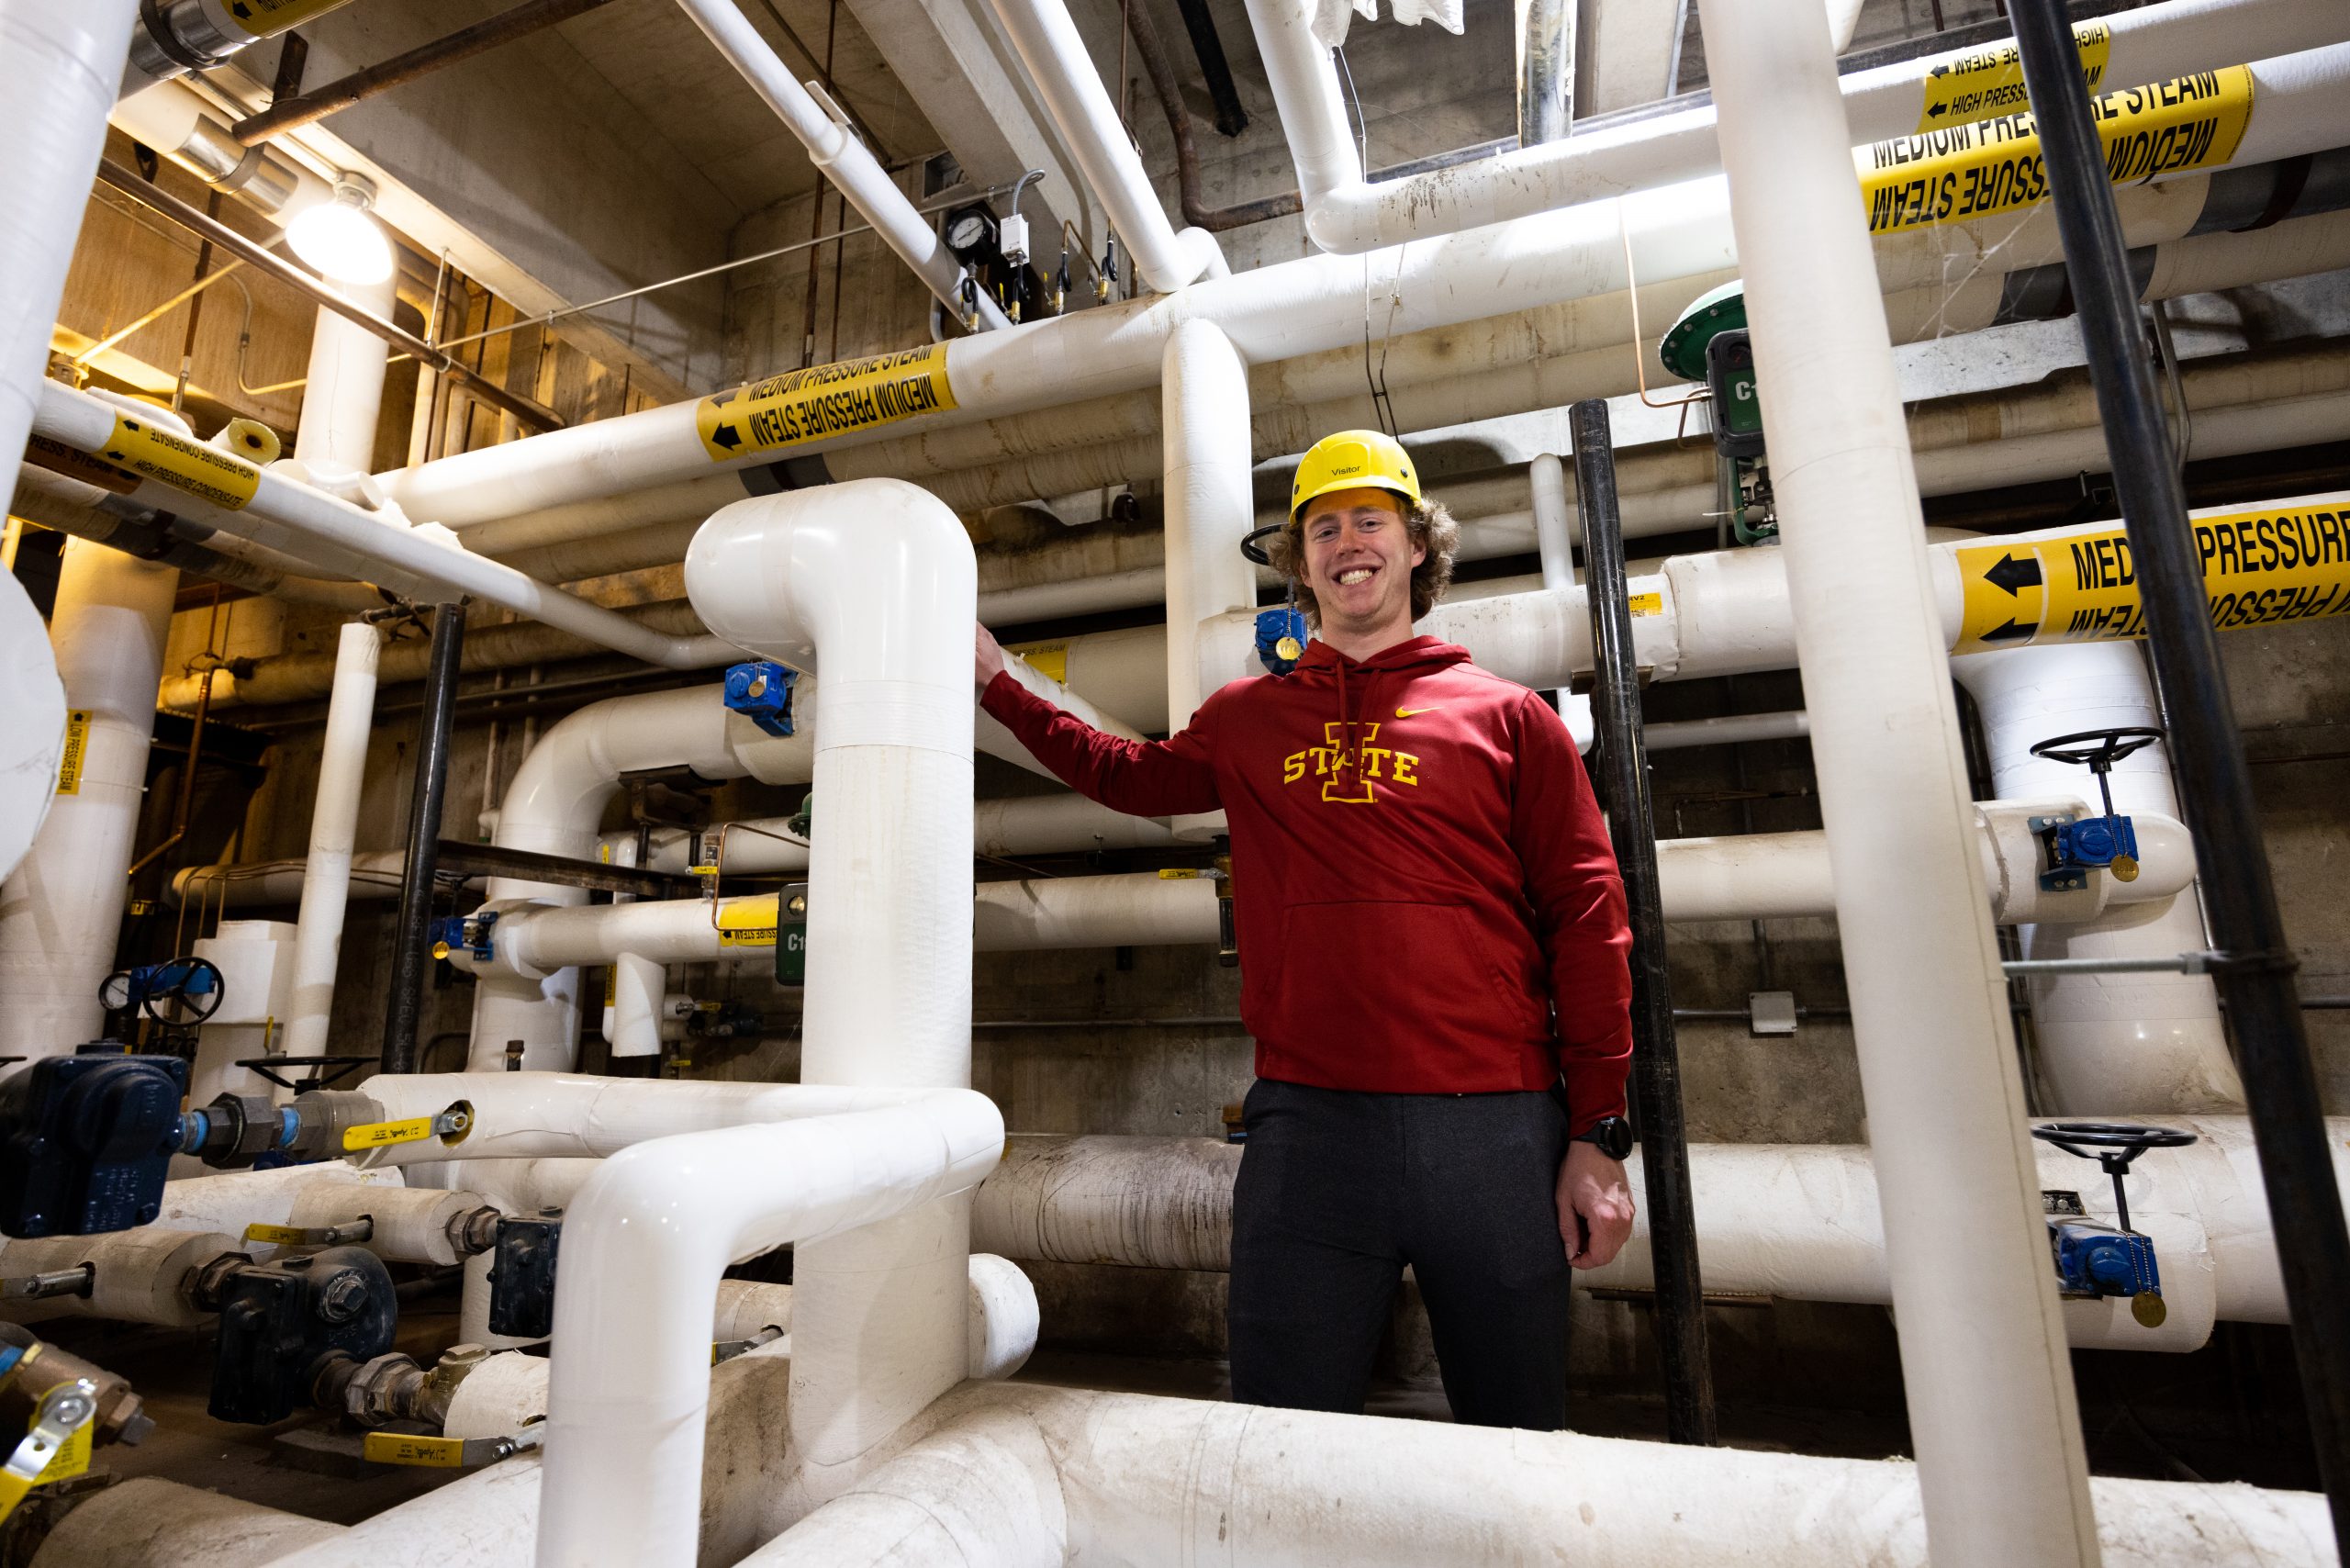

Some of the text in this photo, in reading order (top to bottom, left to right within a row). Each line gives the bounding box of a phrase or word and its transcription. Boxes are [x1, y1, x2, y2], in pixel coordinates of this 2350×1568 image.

[1953, 50, 1997, 76] STEAM
[1874, 119, 1973, 169] MEDIUM
[2125, 71, 2221, 115] STEAM
[1950, 82, 2029, 117] HIGH PRESS
[1869, 118, 2219, 231] MEDIUM SSURE STEAM
[748, 345, 933, 402] MEDIUM PRESSURE STEAM
[1735, 381, 1757, 401] C
[749, 375, 938, 446] MEDIUM PRESSURE STEAM
[29, 434, 67, 458] RESS.
[151, 428, 255, 481] HIGH PRESSURE CONDENSATE
[131, 459, 244, 507] HIGH PRESSURE CONDENSATE
[1331, 465, 1361, 476] Visitor
[2070, 510, 2350, 591] MED PRESSURE
[2066, 604, 2150, 638] TEAM
[2210, 583, 2341, 629] PRESSU
[59, 724, 83, 790] LOW PRESSURE STEAM
[1284, 746, 1419, 787] STATE
[734, 929, 777, 941] SSURE STEAM
[788, 933, 807, 951] C1
